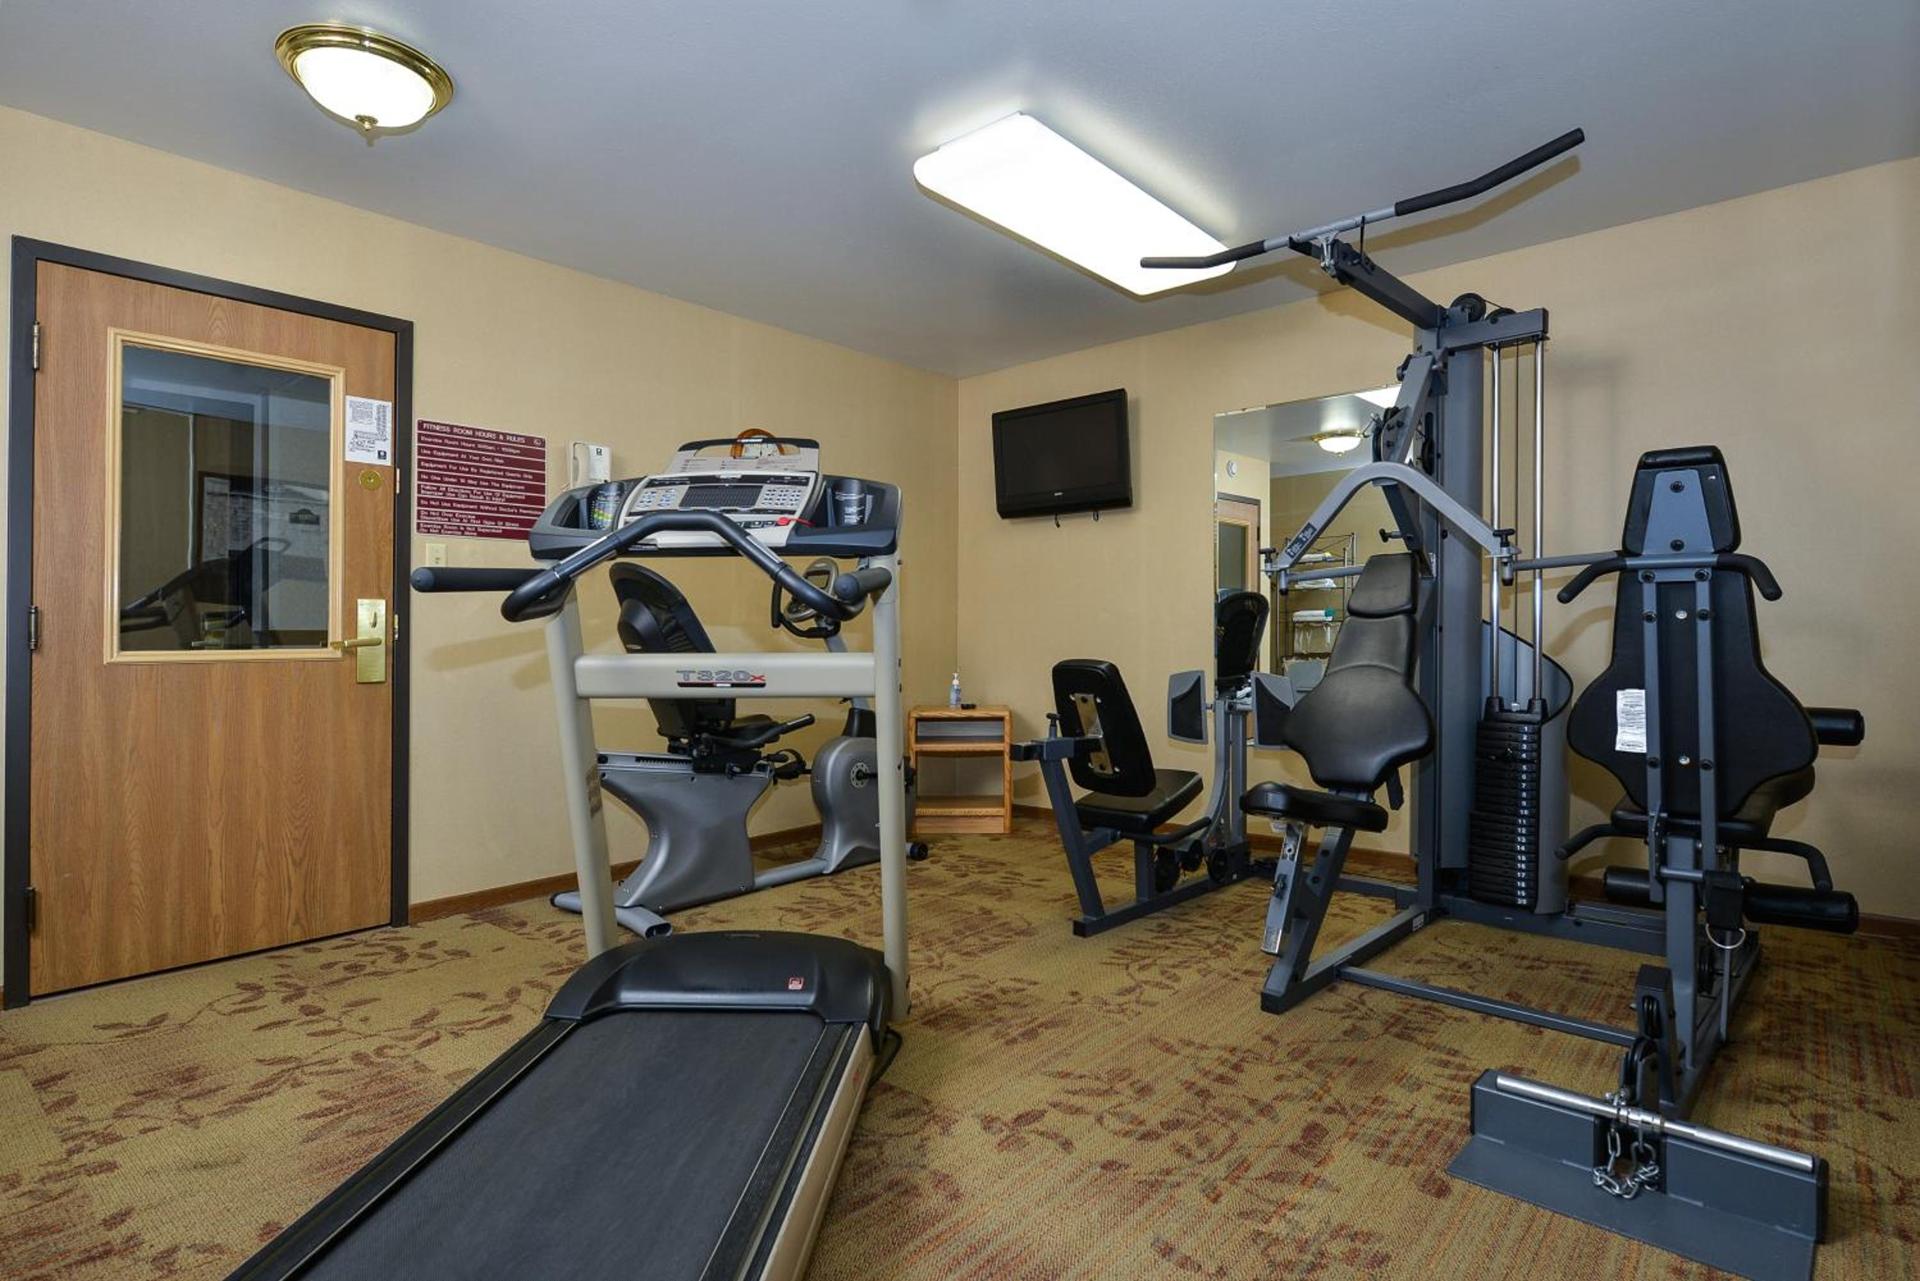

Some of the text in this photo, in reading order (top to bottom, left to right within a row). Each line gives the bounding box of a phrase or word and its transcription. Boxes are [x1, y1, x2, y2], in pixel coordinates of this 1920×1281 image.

[423, 423, 451, 432] FITNESS
[453, 427, 473, 435] ROOM
[475, 430, 497, 440] HOURS
[506, 435, 526, 443] RULES
